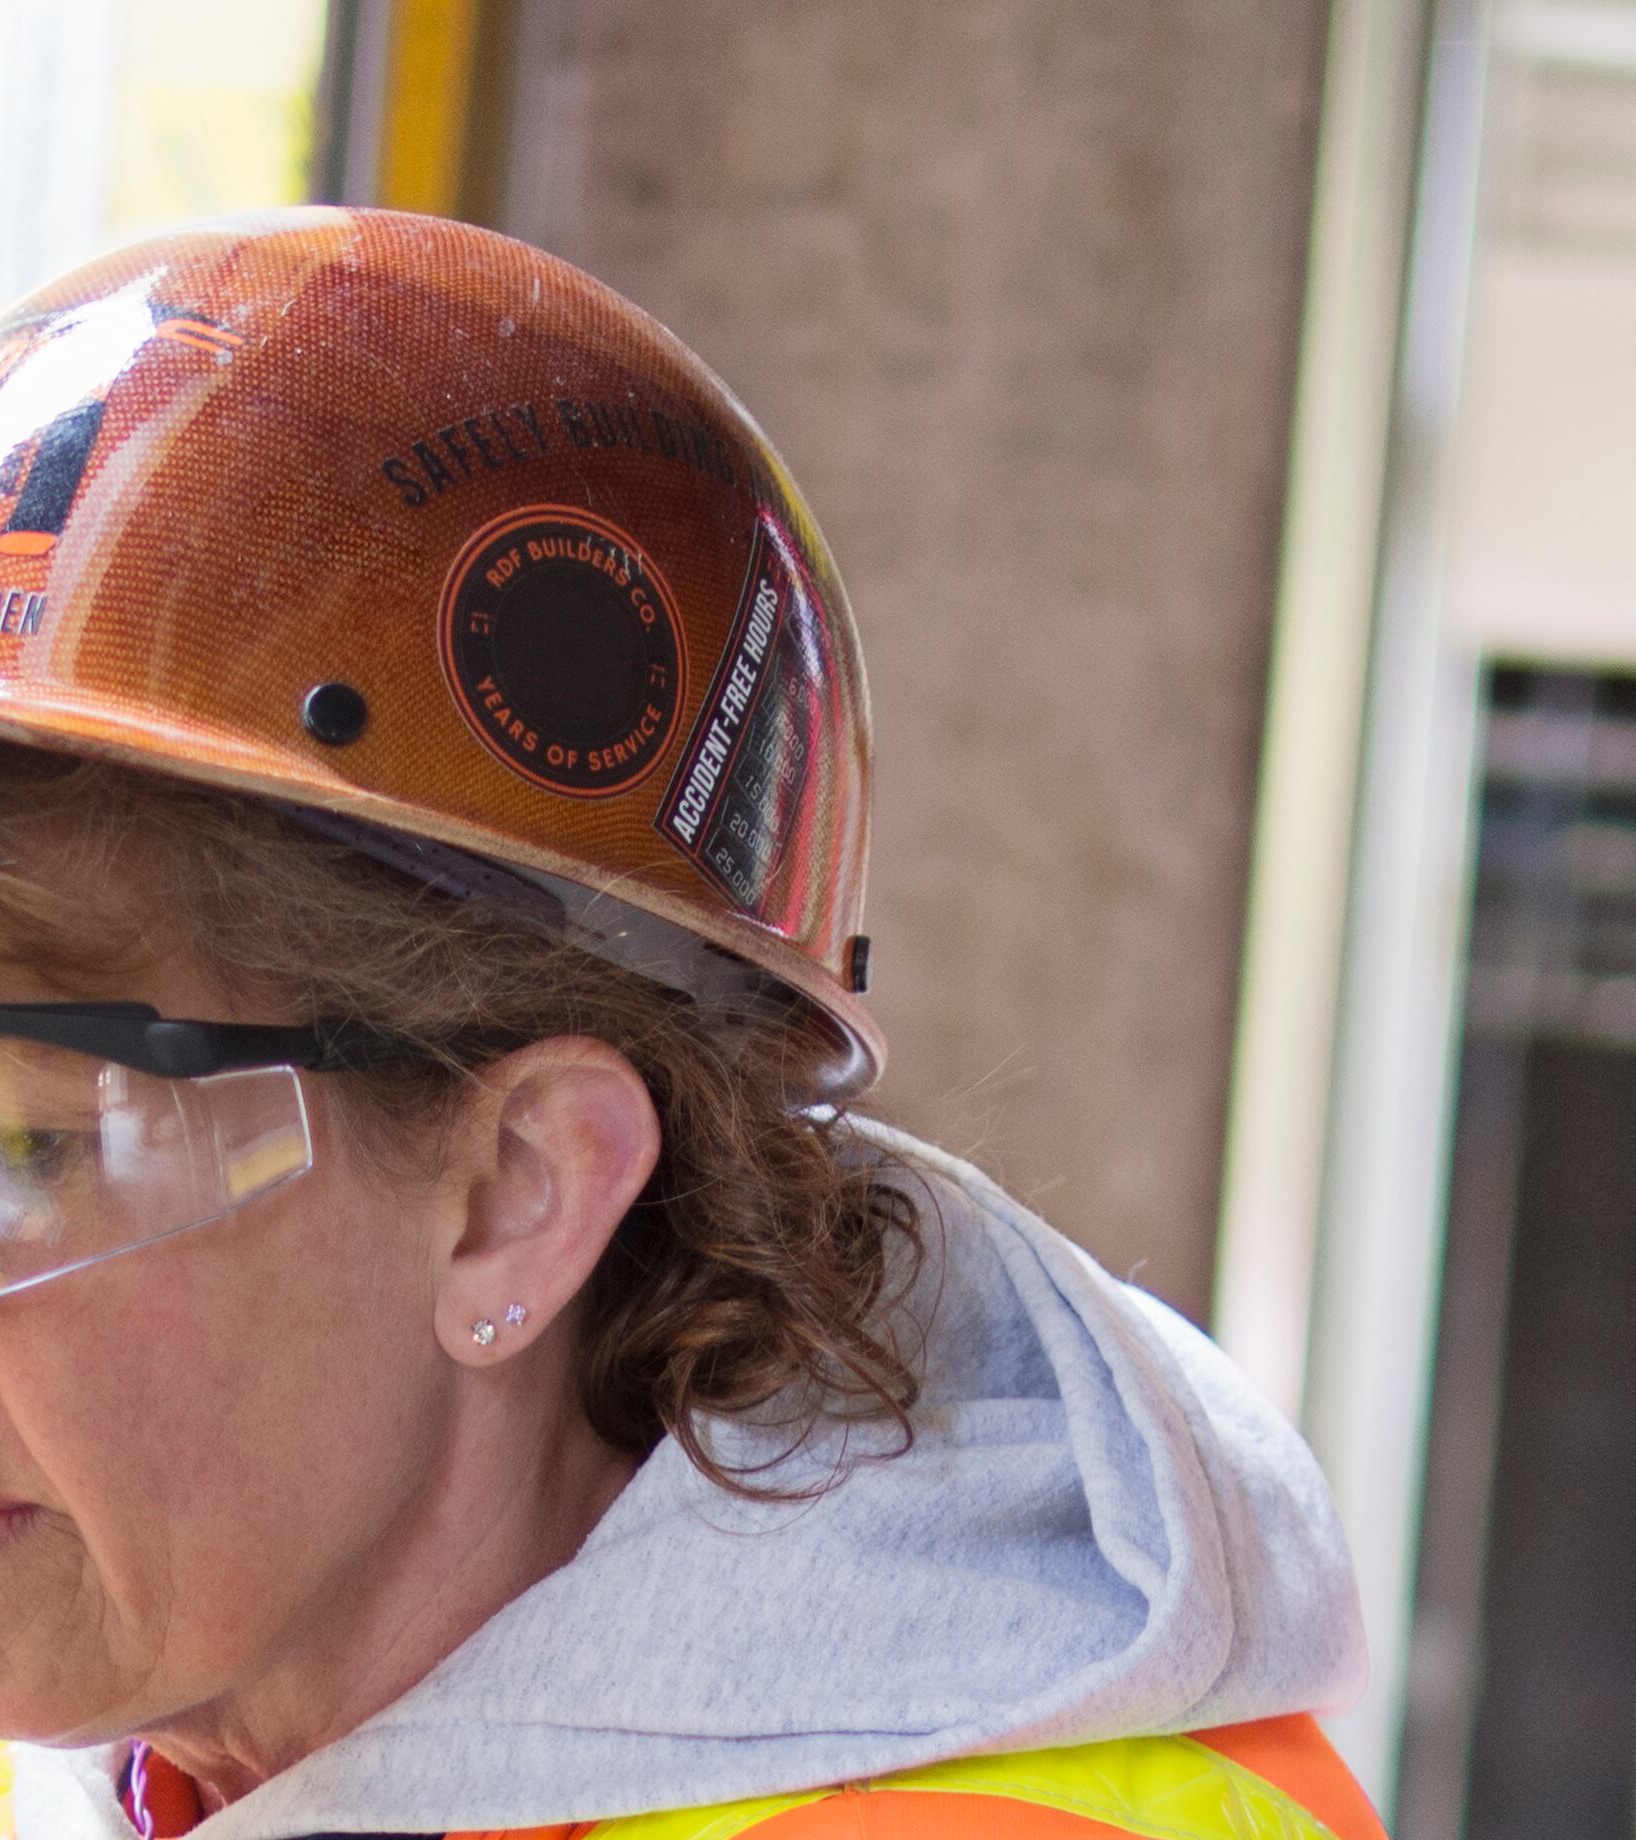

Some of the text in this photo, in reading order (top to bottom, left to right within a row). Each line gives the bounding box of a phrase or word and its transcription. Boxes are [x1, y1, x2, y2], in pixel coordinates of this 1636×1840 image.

[380, 400, 550, 507] SAFELY
[557, 397, 738, 490] BUILDING
[484, 537, 657, 633] RDF BUILDERS CO.
[476, 675, 662, 772] YEARS OF SERVICE
[671, 653, 758, 842] ACCIDENT-FREE
[742, 578, 779, 665] HOURS
